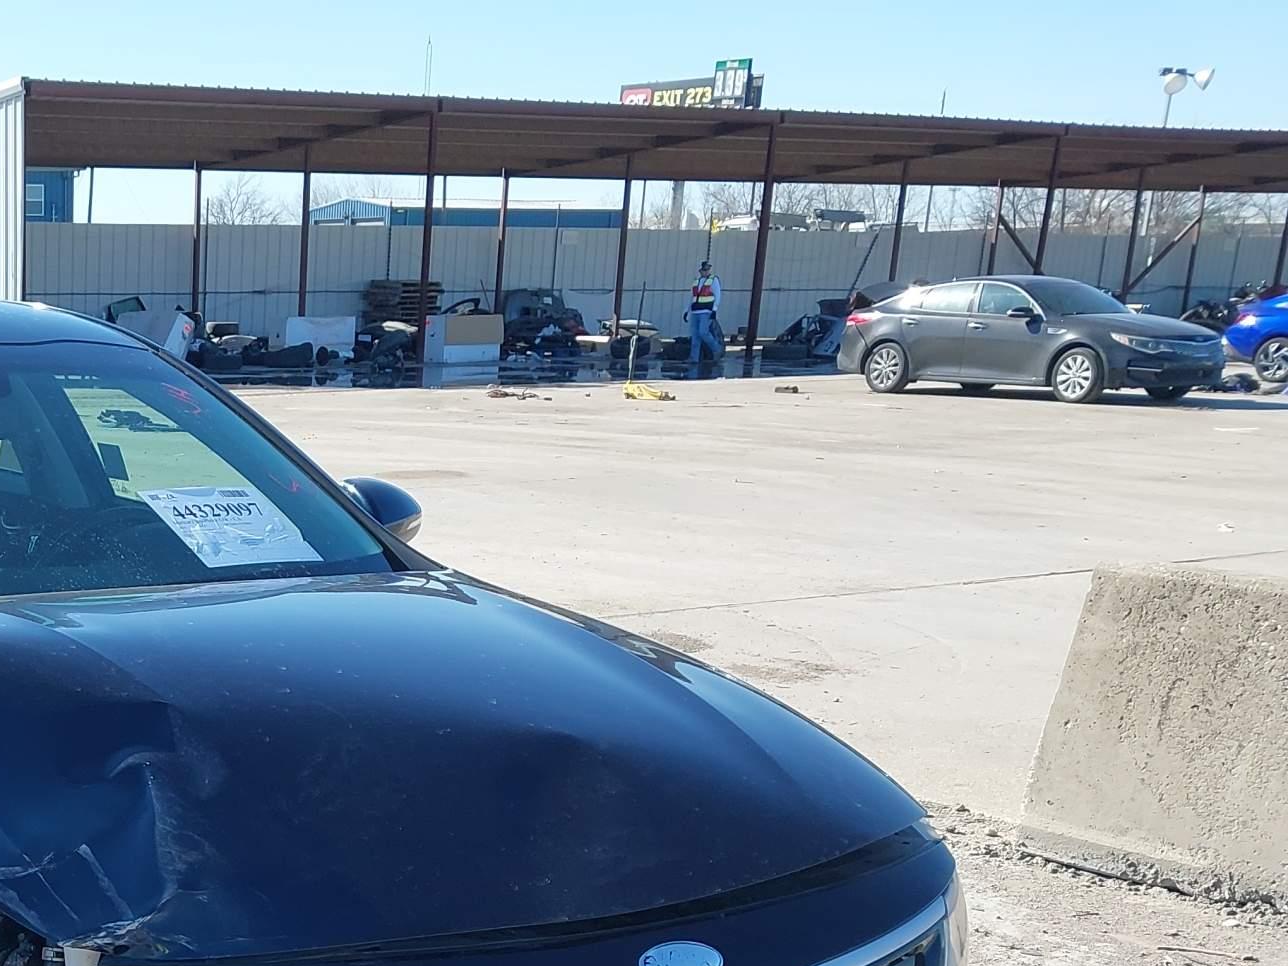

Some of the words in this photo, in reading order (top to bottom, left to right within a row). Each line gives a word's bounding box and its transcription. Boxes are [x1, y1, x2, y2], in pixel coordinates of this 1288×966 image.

[653, 89, 684, 106] EXIT
[685, 86, 712, 105] 273
[172, 502, 263, 519] 44329097
